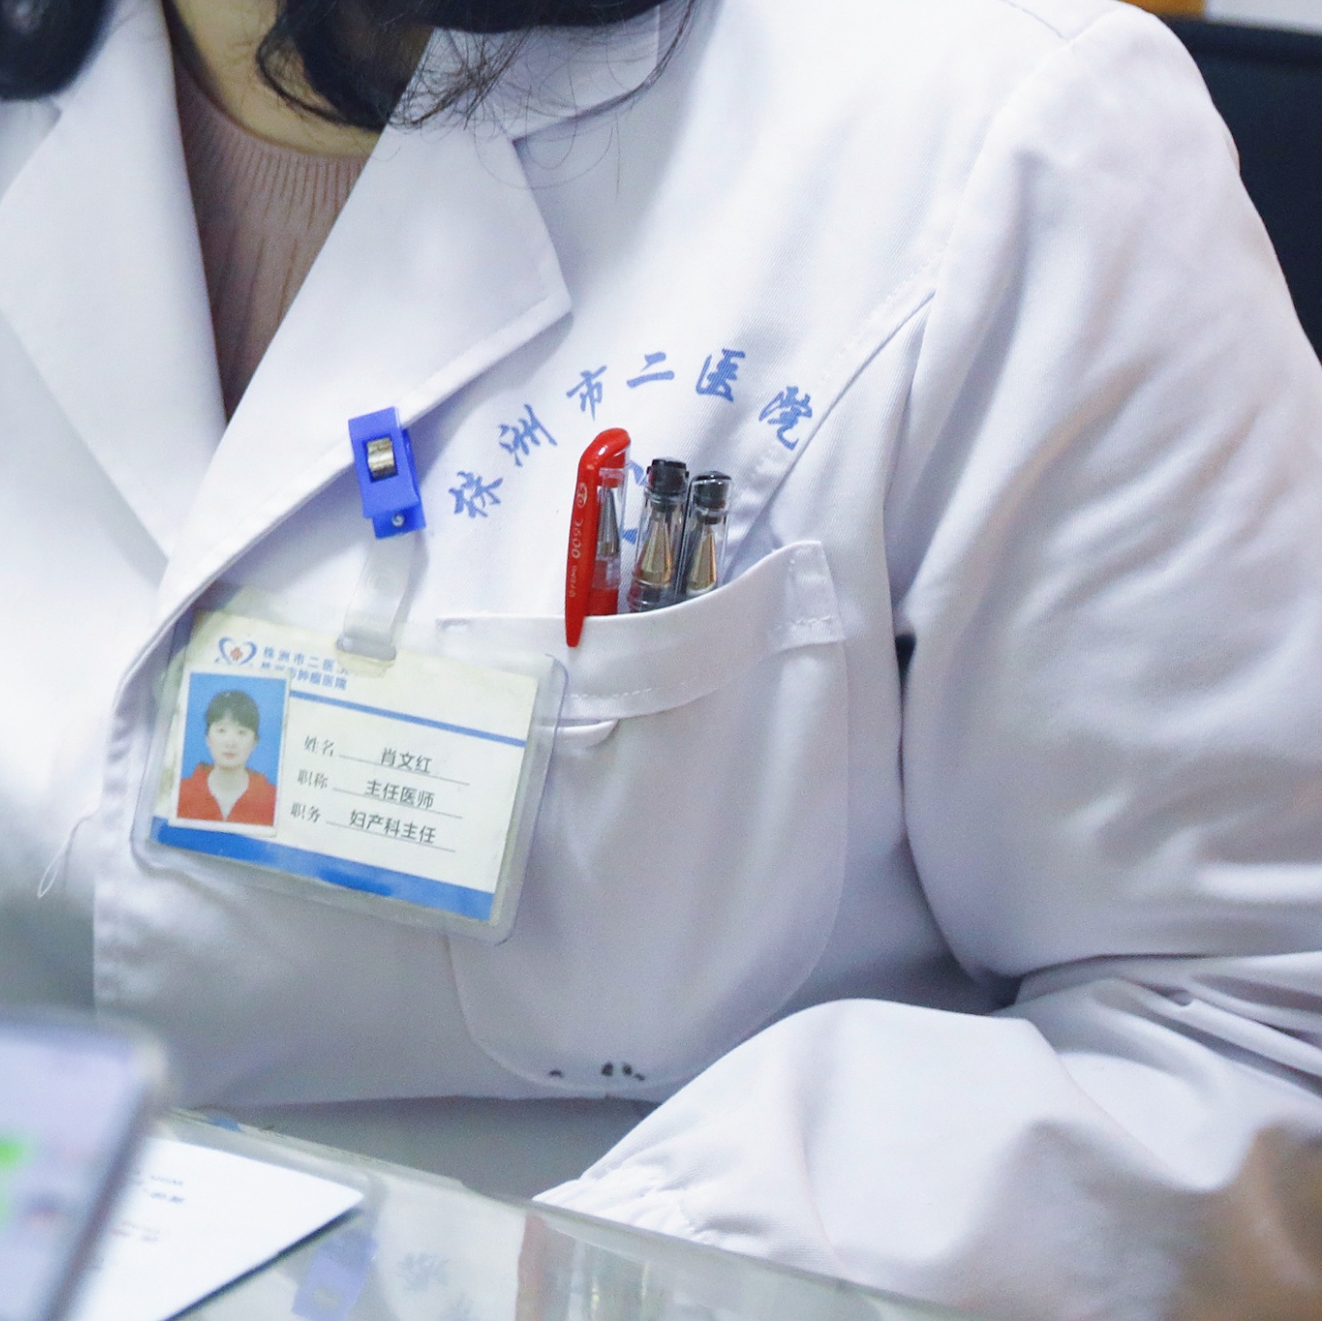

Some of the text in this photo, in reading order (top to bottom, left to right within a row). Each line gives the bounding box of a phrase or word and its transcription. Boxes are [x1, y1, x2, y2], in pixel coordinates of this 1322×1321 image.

[304, 735, 433, 775] 姓名 肖文红
[297, 768, 436, 809] 职称 主任医师
[291, 801, 437, 844] 职务 妇产科主任
